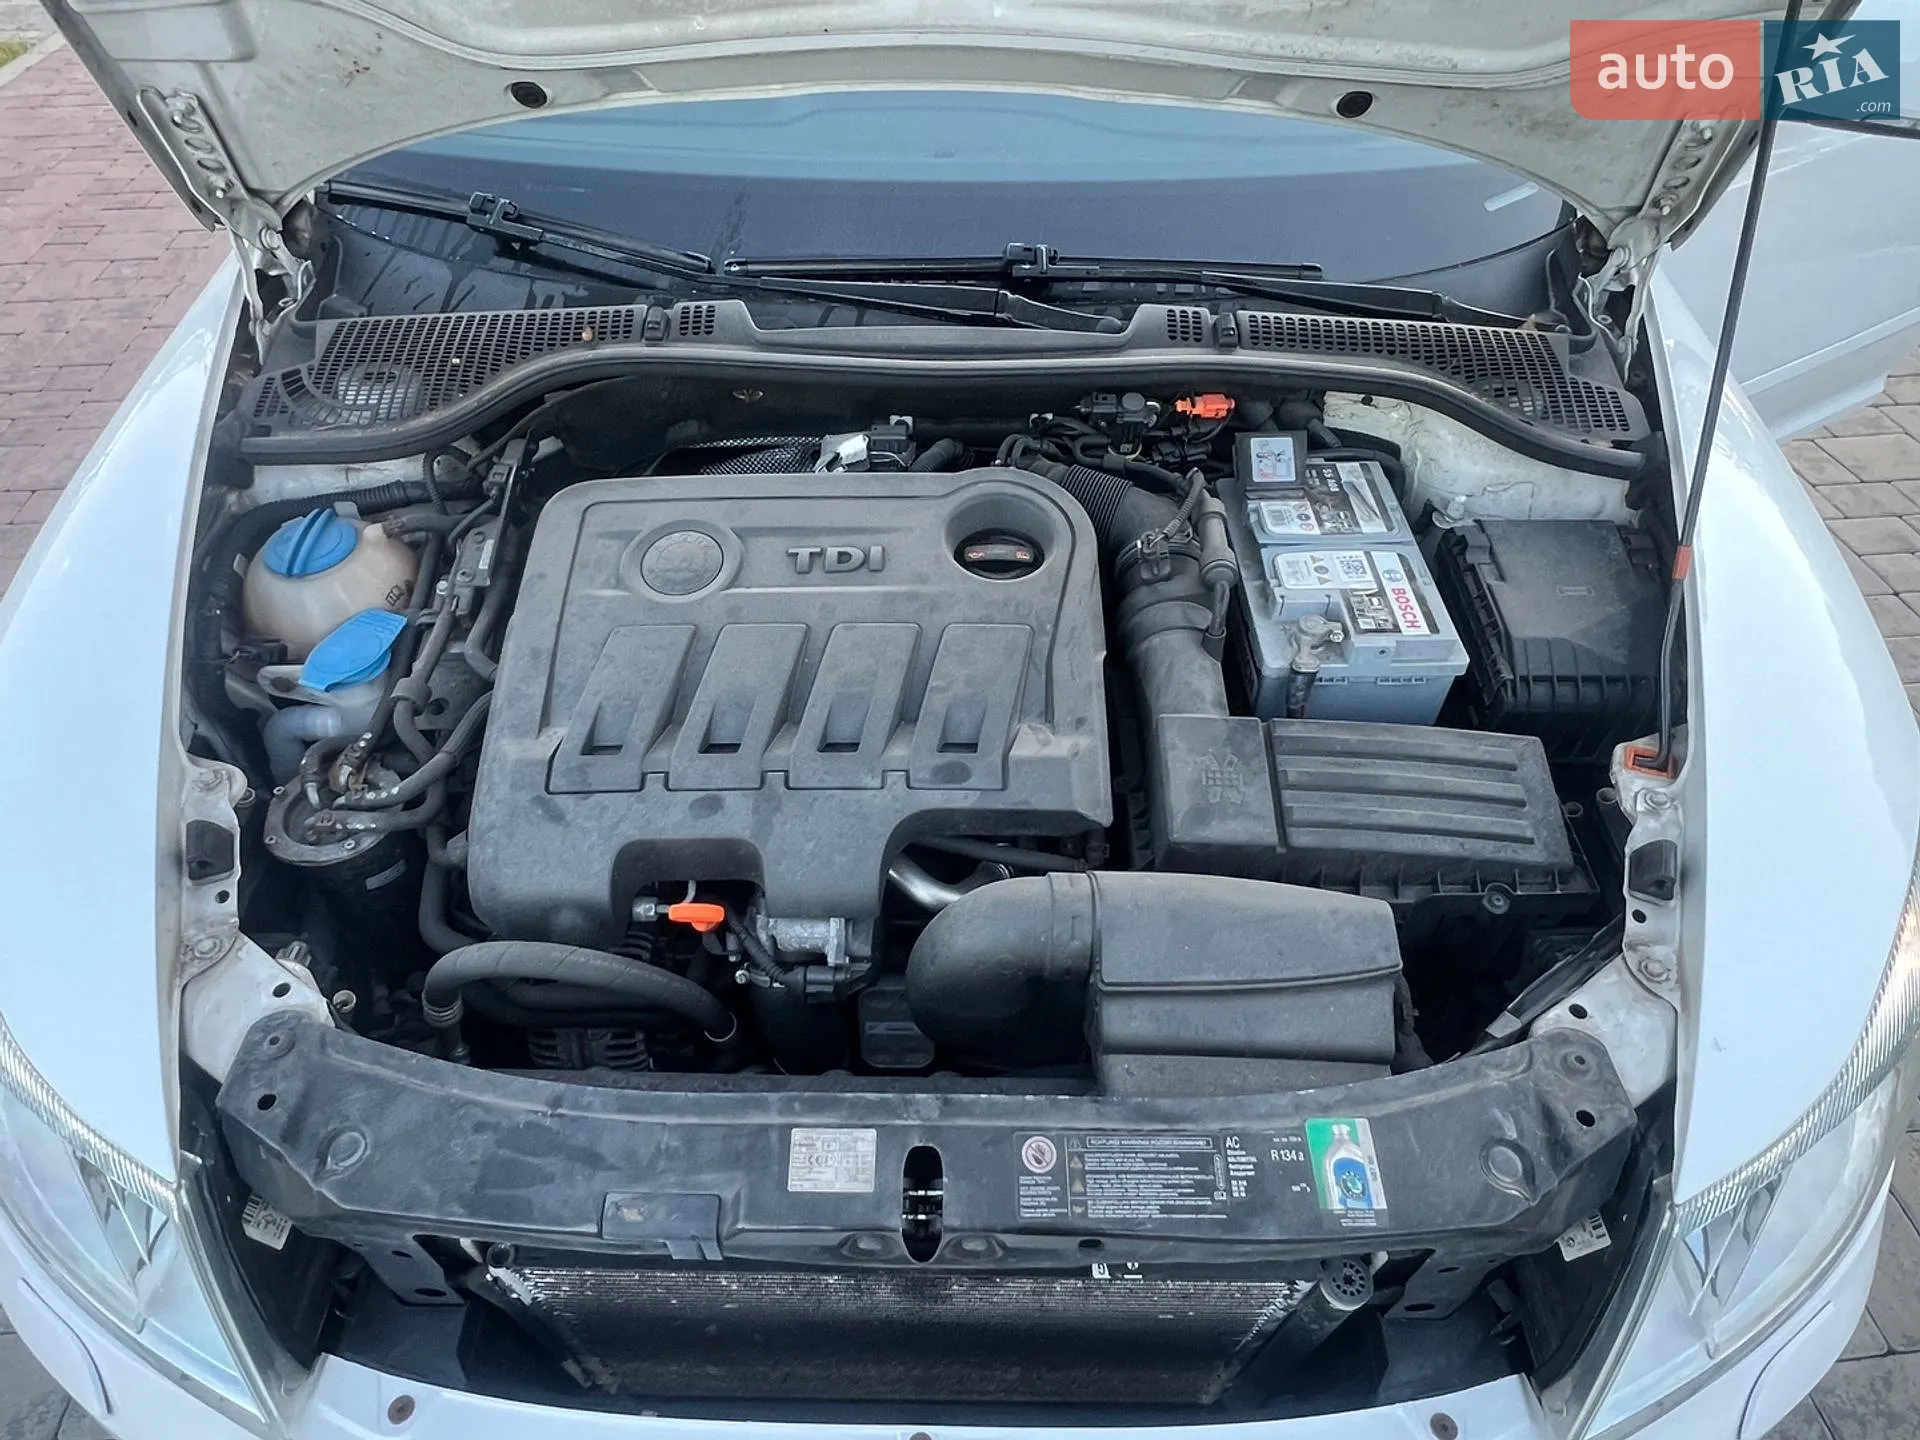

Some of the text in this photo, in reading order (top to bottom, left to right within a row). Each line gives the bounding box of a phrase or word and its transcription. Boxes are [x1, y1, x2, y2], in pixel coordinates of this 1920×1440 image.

[786, 545, 885, 574] TDI
[1391, 587, 1421, 629] BOSCH
[1225, 1135, 1240, 1149] AC
